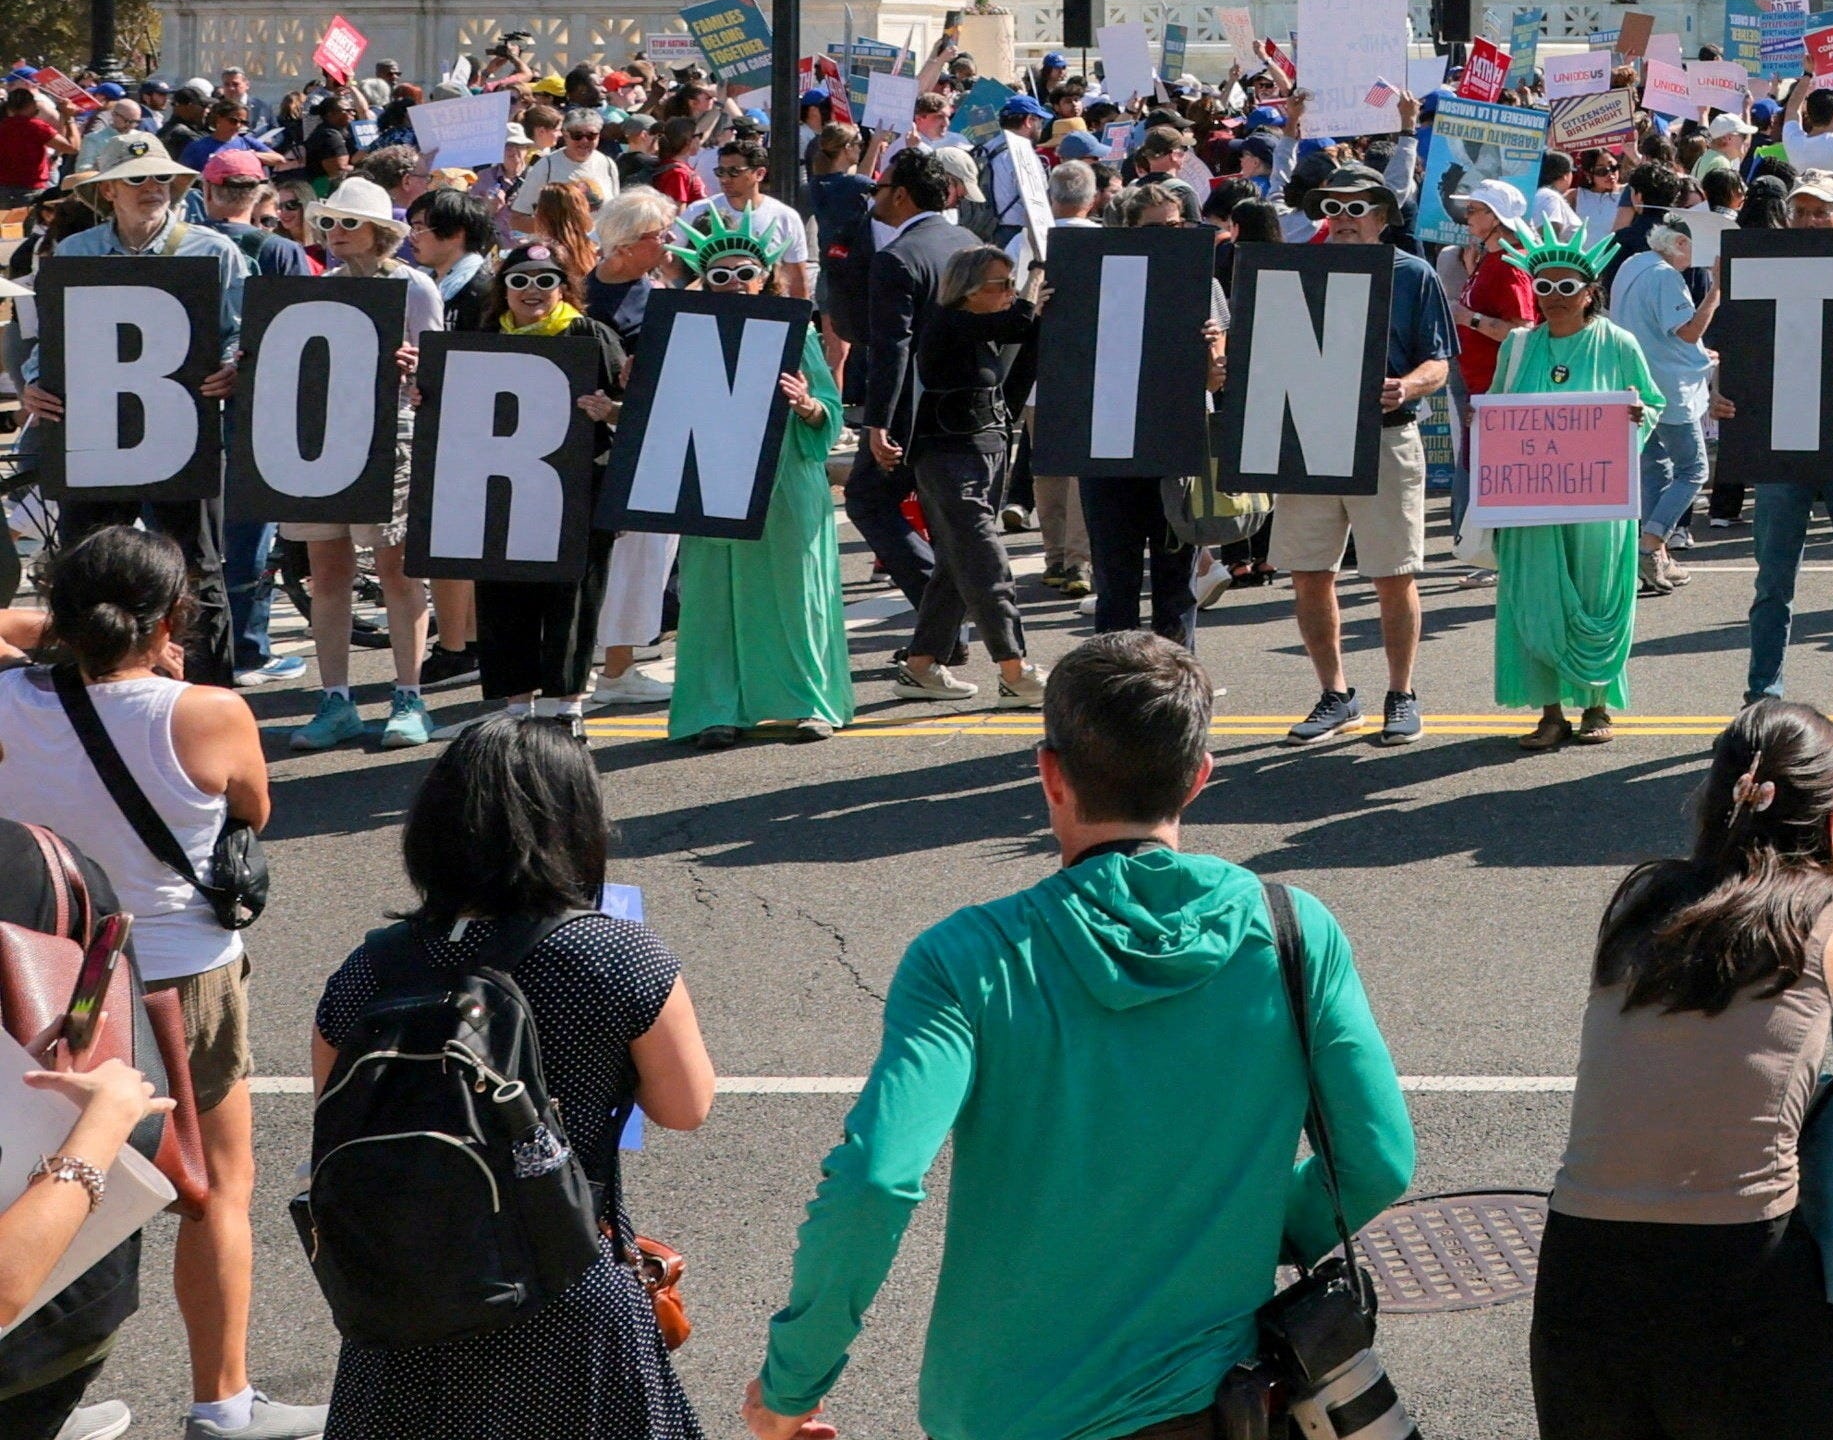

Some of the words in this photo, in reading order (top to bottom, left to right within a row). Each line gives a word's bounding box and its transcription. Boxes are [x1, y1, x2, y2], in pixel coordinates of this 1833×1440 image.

[692, 8, 746, 35] FAMILIES
[700, 26, 746, 50] BELONG
[1817, 44, 1833, 53] CON
[1561, 99, 1622, 129] CITIZENSHIP
[1565, 107, 1624, 137] BIRTHRIGHT
[1484, 406, 1603, 432] CITZENSHIP
[1521, 438, 1535, 456] IS
[1546, 438, 1559, 456] A
[1480, 460, 1613, 496] BIRTHRIGHT
